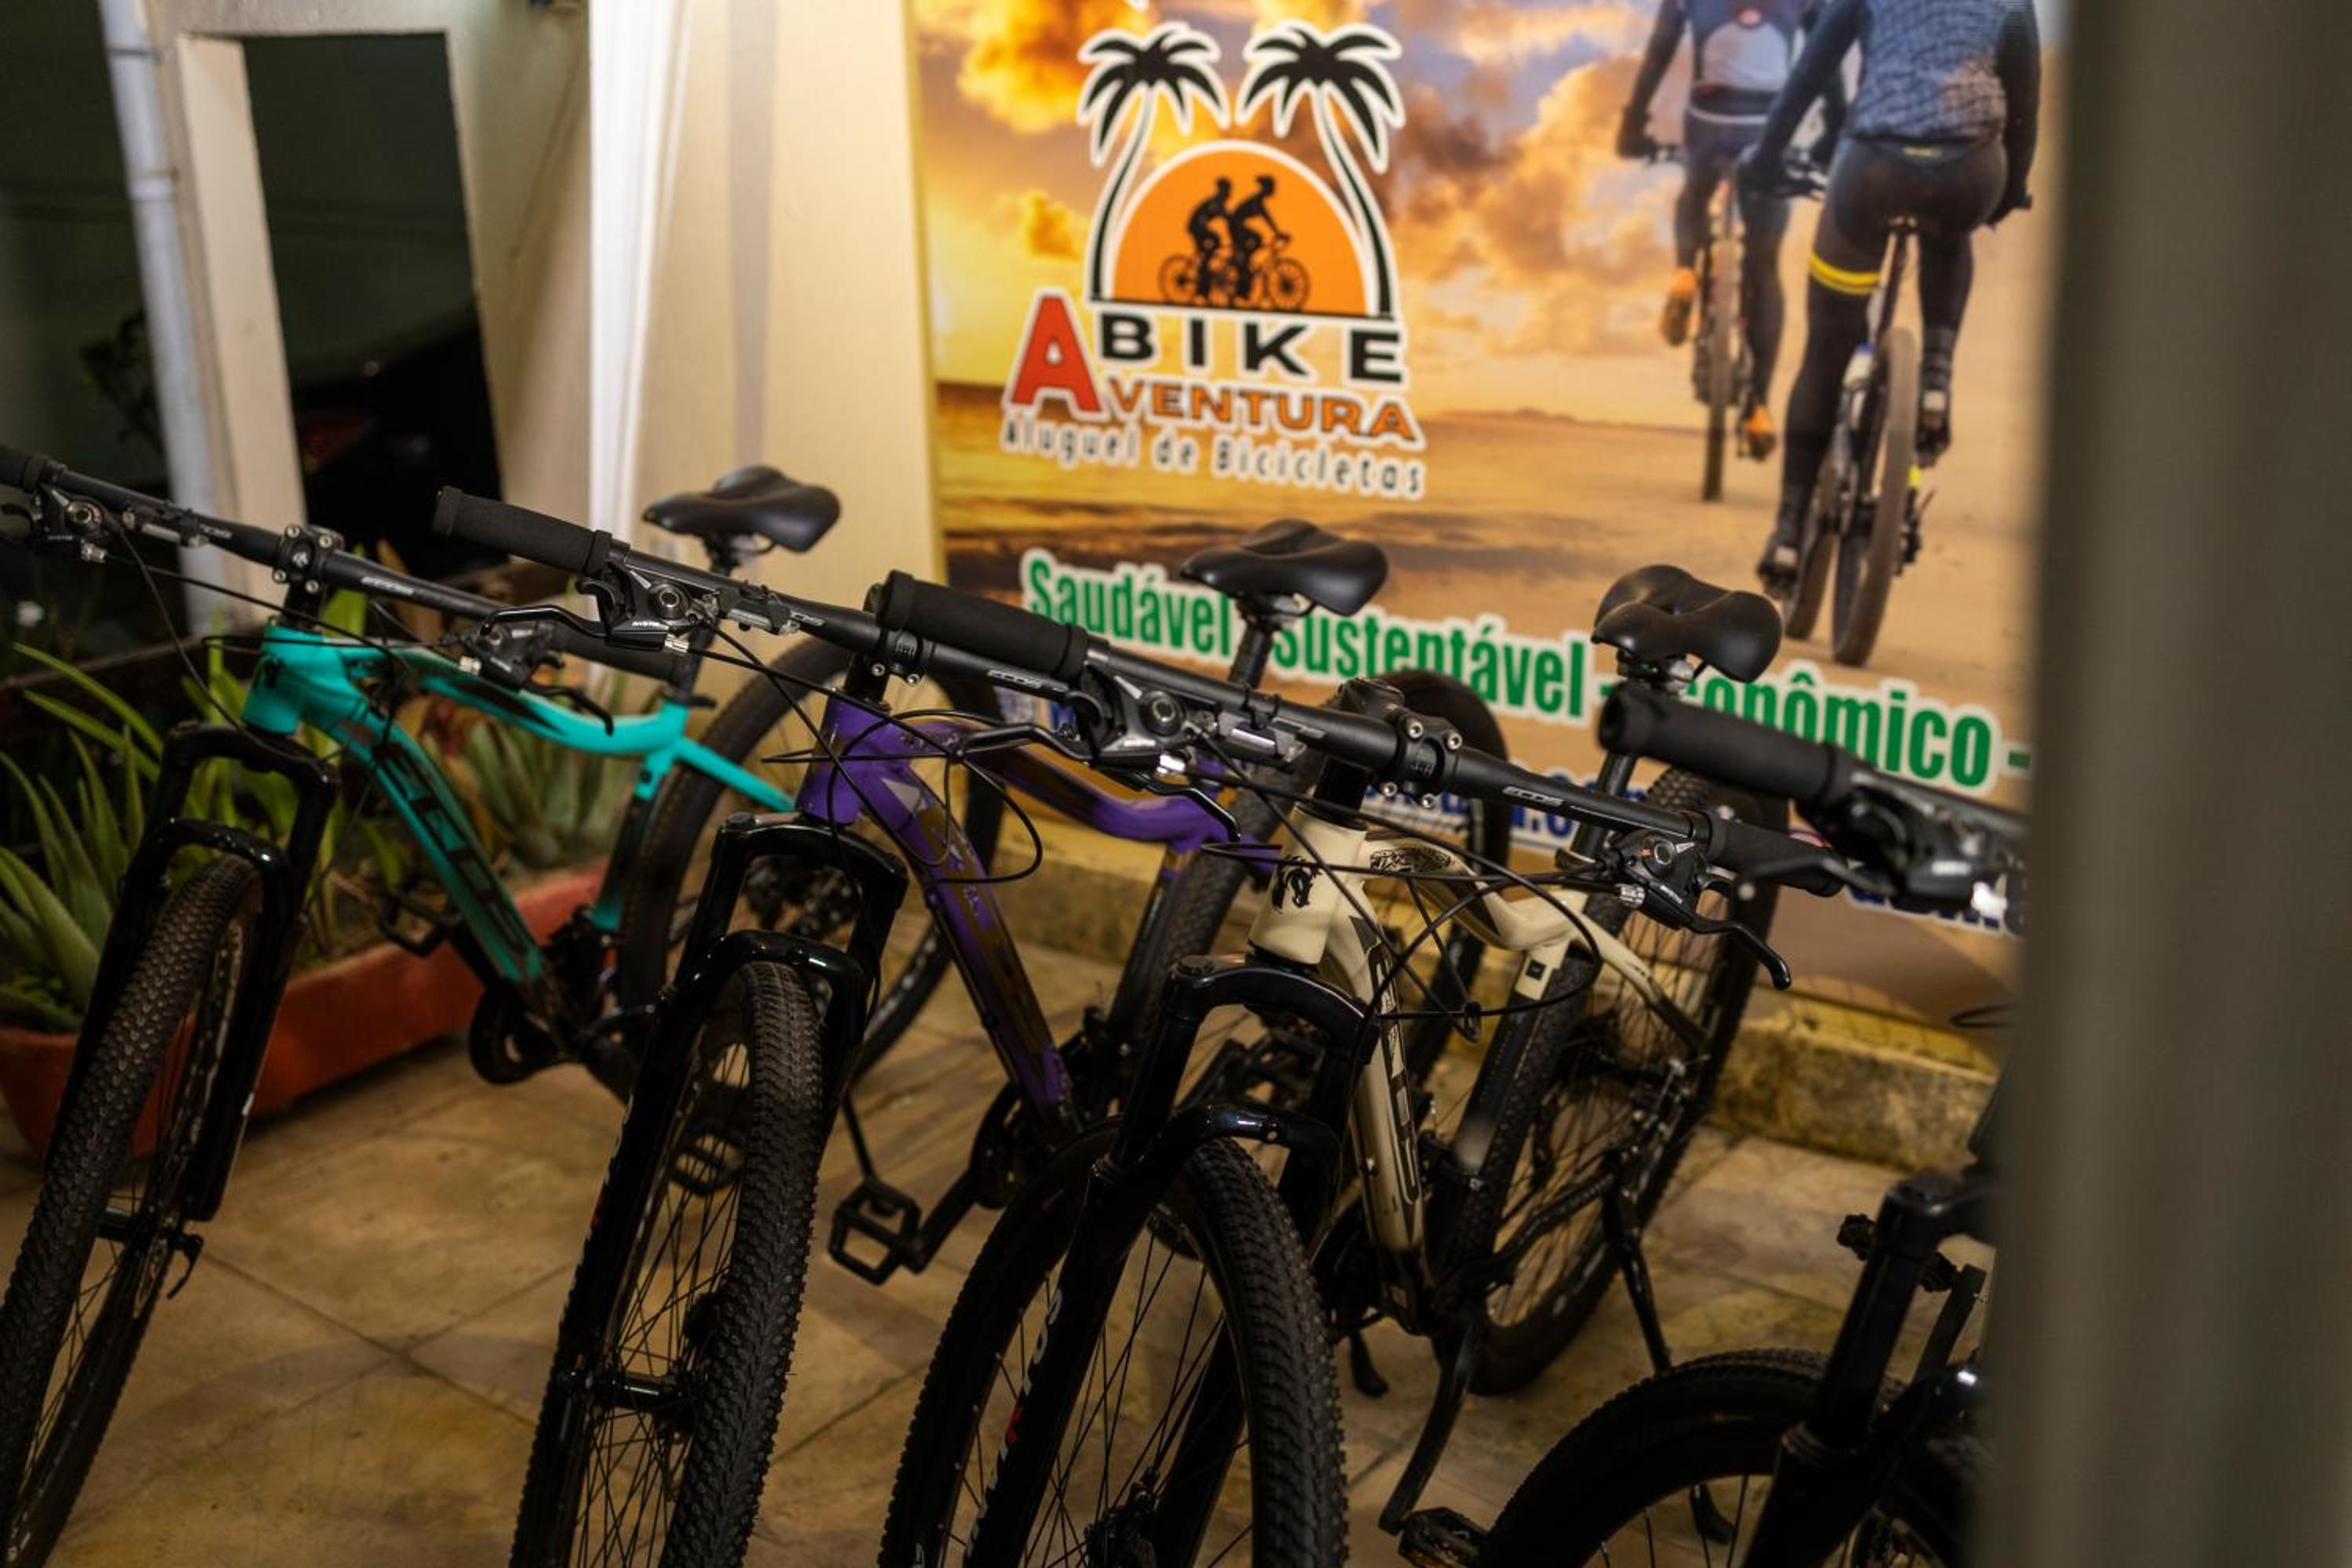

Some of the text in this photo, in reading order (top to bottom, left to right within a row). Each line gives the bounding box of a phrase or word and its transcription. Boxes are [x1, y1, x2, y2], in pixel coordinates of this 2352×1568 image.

[1101, 313, 1402, 383] BIKE
[1004, 419, 1421, 494] Aluguel de Bicicletas
[1029, 558, 1230, 657] Saudável
